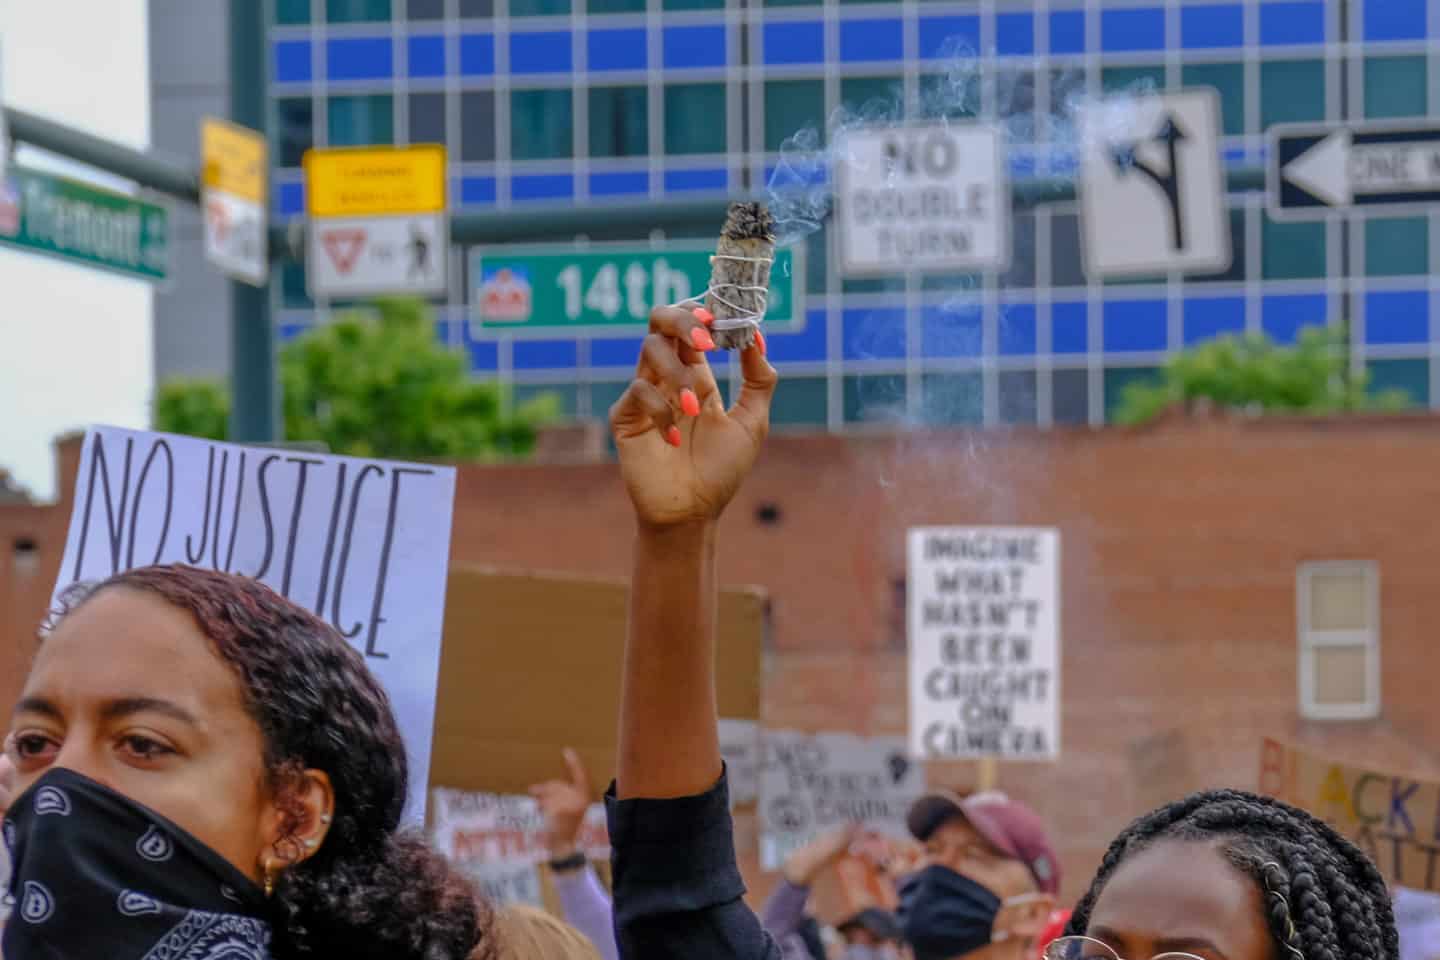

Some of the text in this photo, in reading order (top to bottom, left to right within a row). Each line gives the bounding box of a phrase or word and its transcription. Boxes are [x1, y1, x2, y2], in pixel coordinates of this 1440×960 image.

[880, 135, 957, 178] NO
[1352, 147, 1408, 180] ONE
[855, 184, 986, 225] DOUBLE
[878, 227, 972, 260] TURN
[556, 257, 692, 320] 14th
[74, 432, 435, 660] NO JUSTICE
[923, 536, 1041, 562] IMAGINE
[935, 567, 1024, 597] WHAT
[922, 599, 1040, 629] HASN'T
[940, 633, 1032, 664] BEEN
[923, 667, 1050, 701] CAUGHT
[960, 698, 1014, 727] ON
[923, 721, 1048, 757] CAMERA
